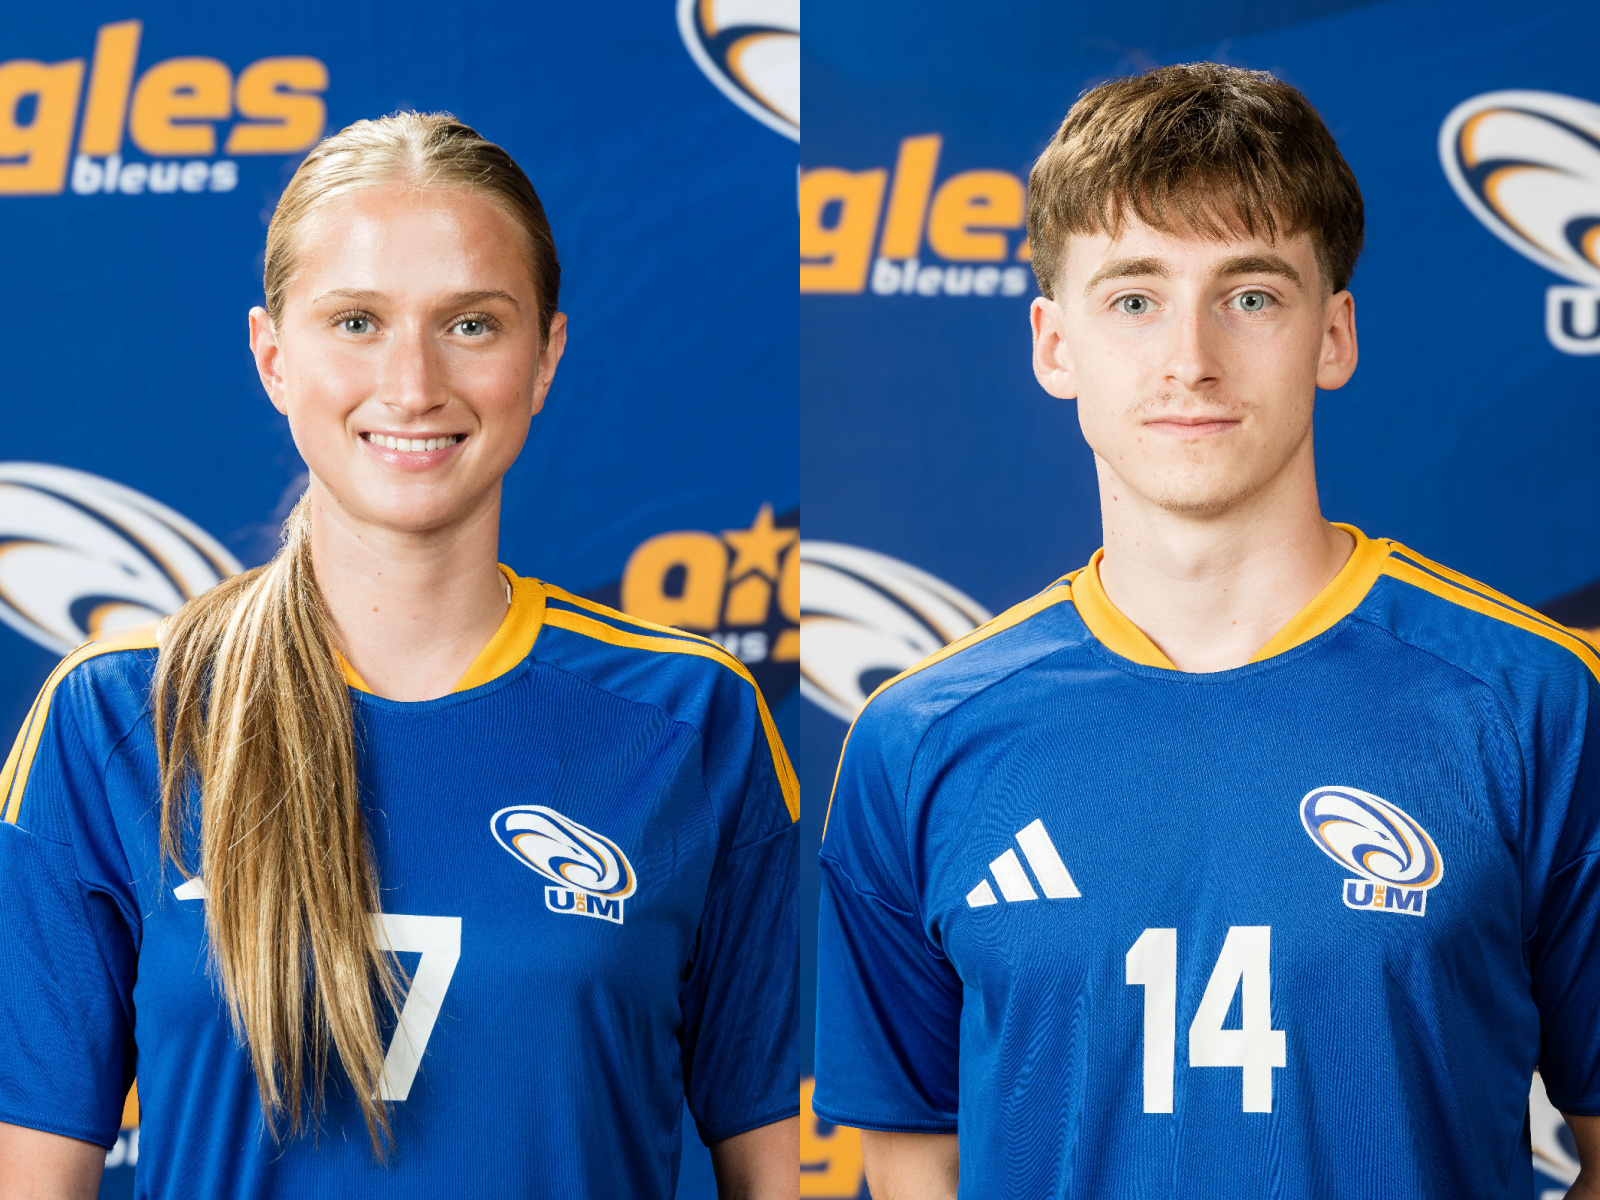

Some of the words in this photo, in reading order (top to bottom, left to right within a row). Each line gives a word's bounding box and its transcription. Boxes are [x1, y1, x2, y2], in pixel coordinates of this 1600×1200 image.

[72, 153, 239, 194] bleues
[800, 134, 1031, 294] gle
[872, 256, 1028, 296] bleues
[368, 913, 462, 1101] 7
[1126, 925, 1286, 1113] 14
